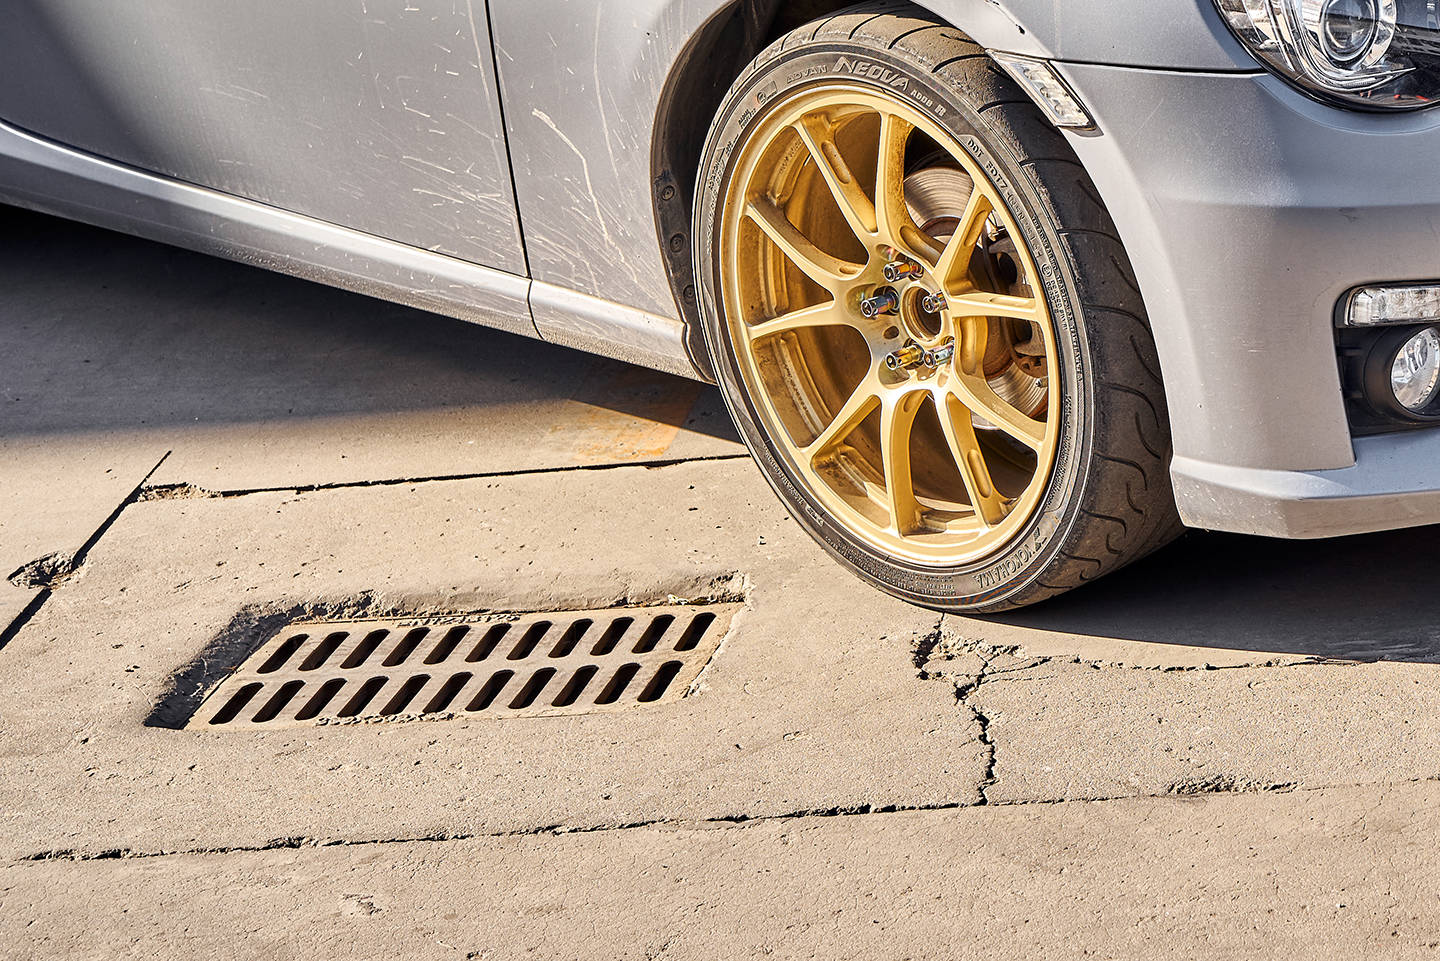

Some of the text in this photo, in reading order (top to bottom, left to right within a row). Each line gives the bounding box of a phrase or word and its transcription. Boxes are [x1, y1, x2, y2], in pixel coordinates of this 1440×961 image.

[786, 63, 828, 85] ADVAN
[832, 55, 910, 92] NEOVA
[967, 138, 985, 158] DOT
[975, 543, 1035, 589] YOKOHAMA
